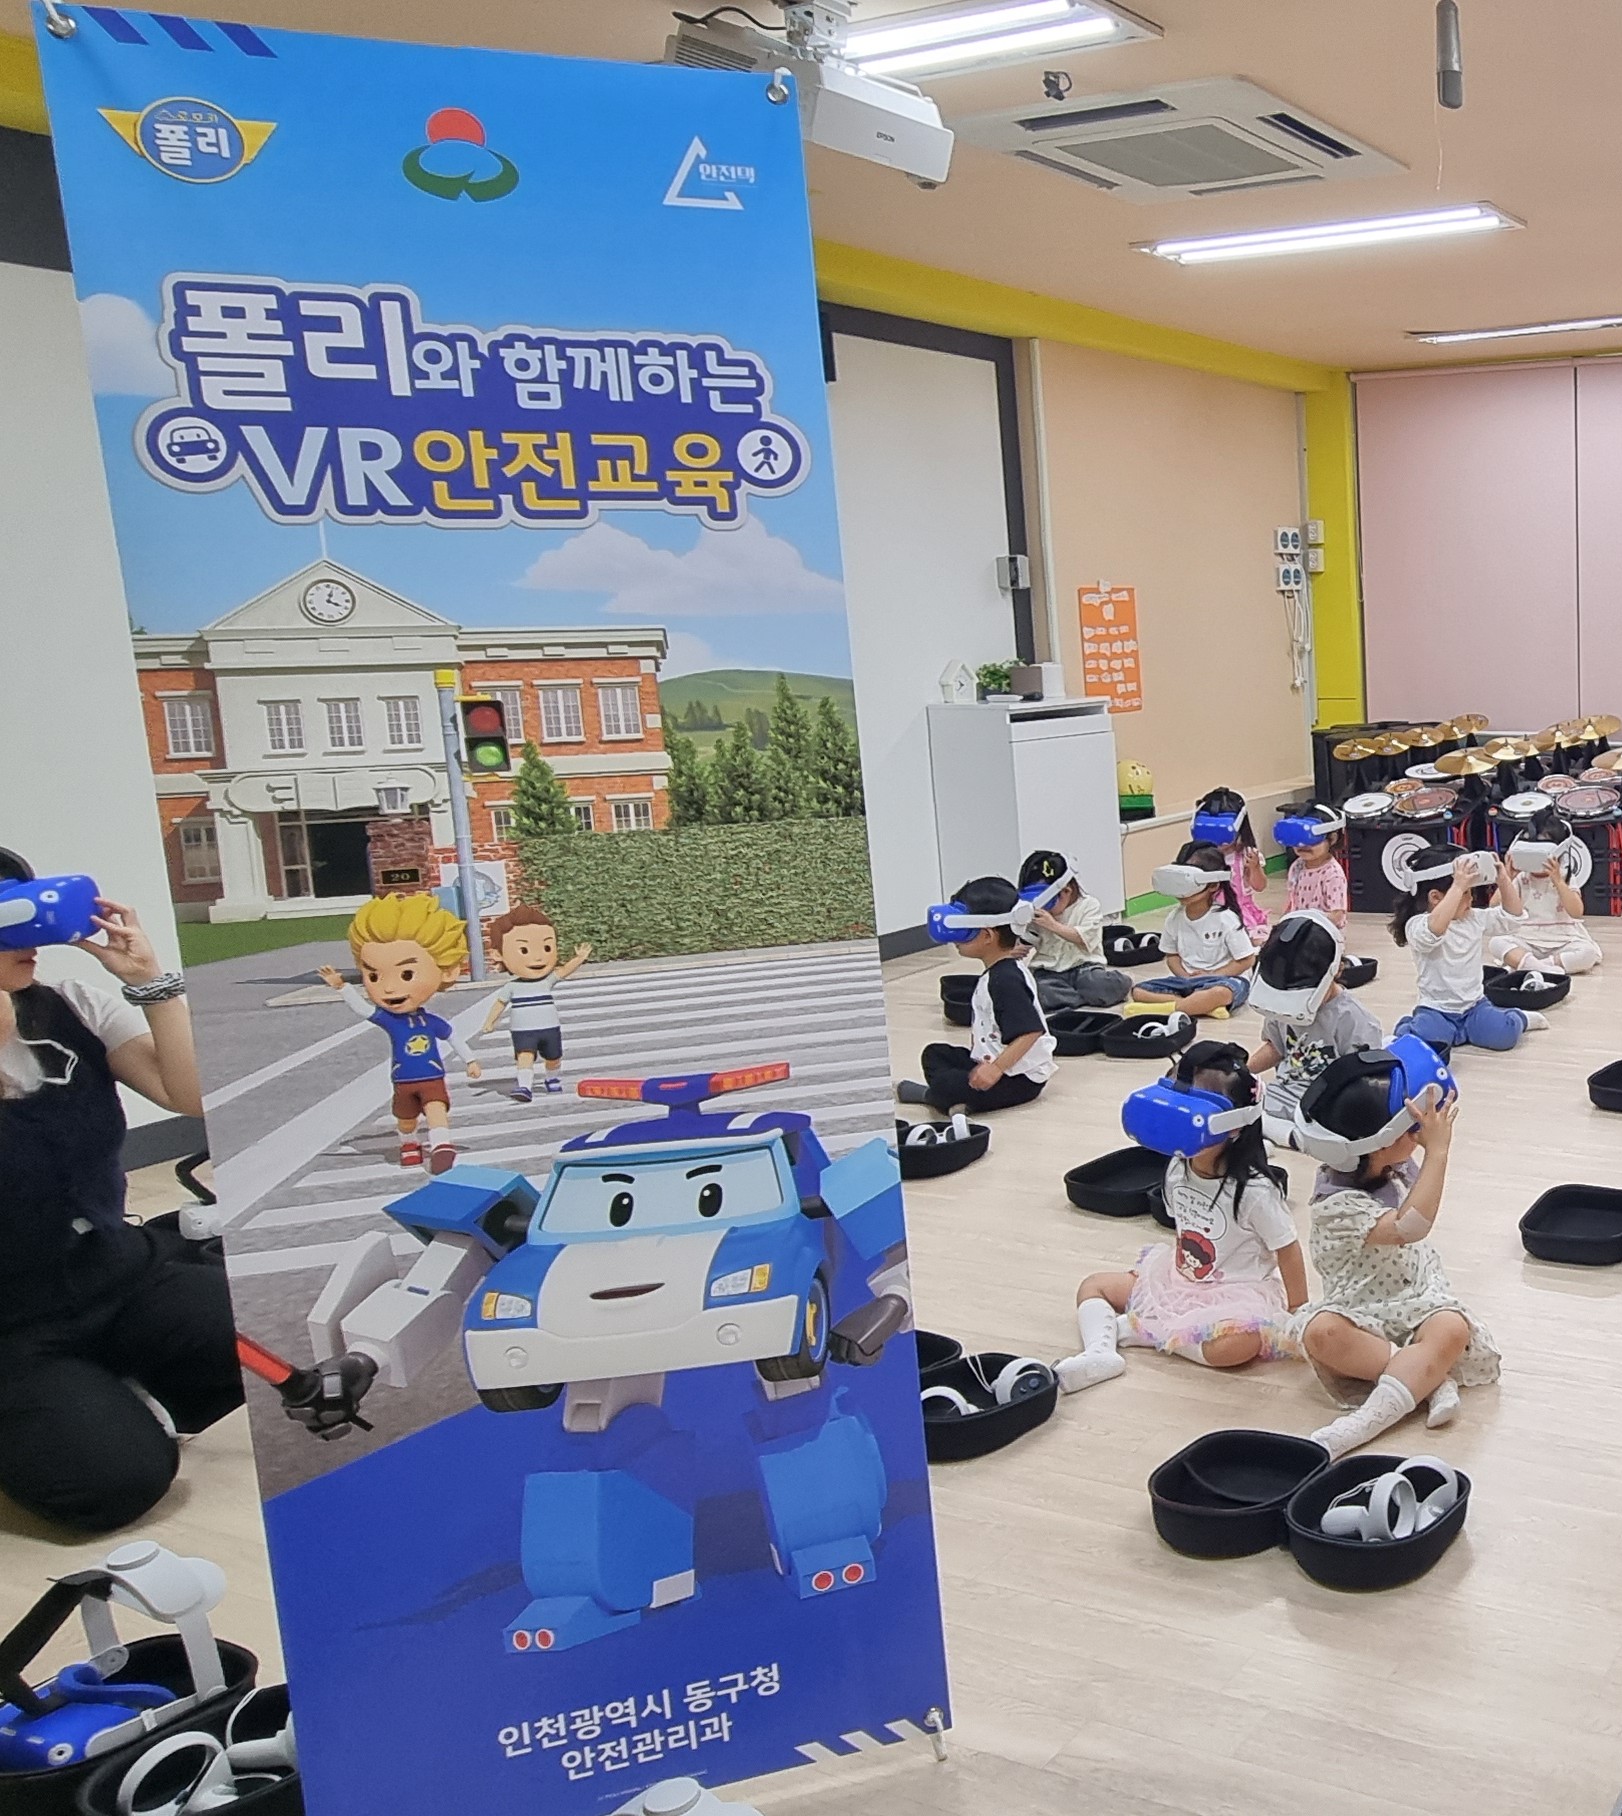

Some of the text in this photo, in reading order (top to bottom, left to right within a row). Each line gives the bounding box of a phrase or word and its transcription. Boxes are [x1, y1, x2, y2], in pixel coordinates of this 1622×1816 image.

[152, 123, 231, 166] 폴리
[180, 289, 757, 413] 폴리와 함께하는
[389, 872, 411, 882] 20
[498, 1663, 782, 1758] 인천광역시 동구청
[560, 1713, 733, 1782] 안전관리과
